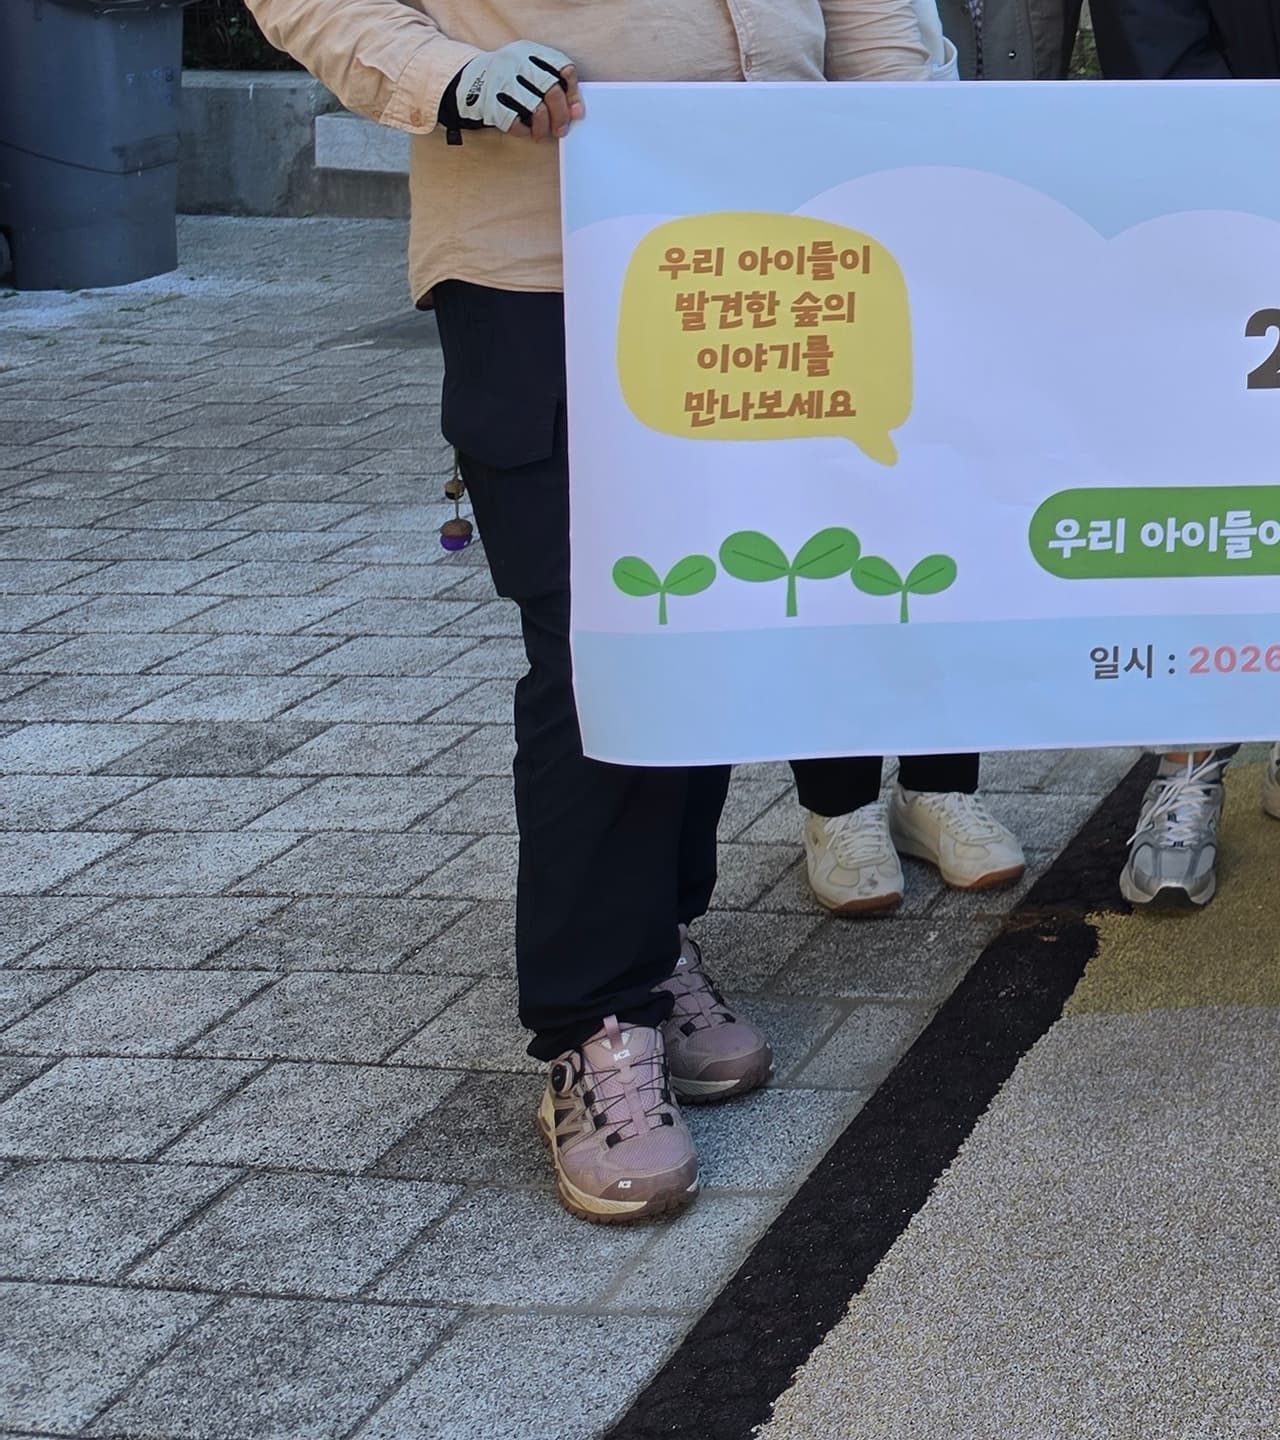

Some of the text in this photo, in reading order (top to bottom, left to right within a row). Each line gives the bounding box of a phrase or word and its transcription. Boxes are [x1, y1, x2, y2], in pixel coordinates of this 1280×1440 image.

[659, 241, 870, 280] 우리 아이들이
[675, 291, 855, 331] 발견한 숲의
[697, 335, 834, 377] 이야기를
[685, 389, 856, 427] 만나보세요
[1048, 518, 1126, 558] 우리
[1090, 645, 1152, 679] 일시
